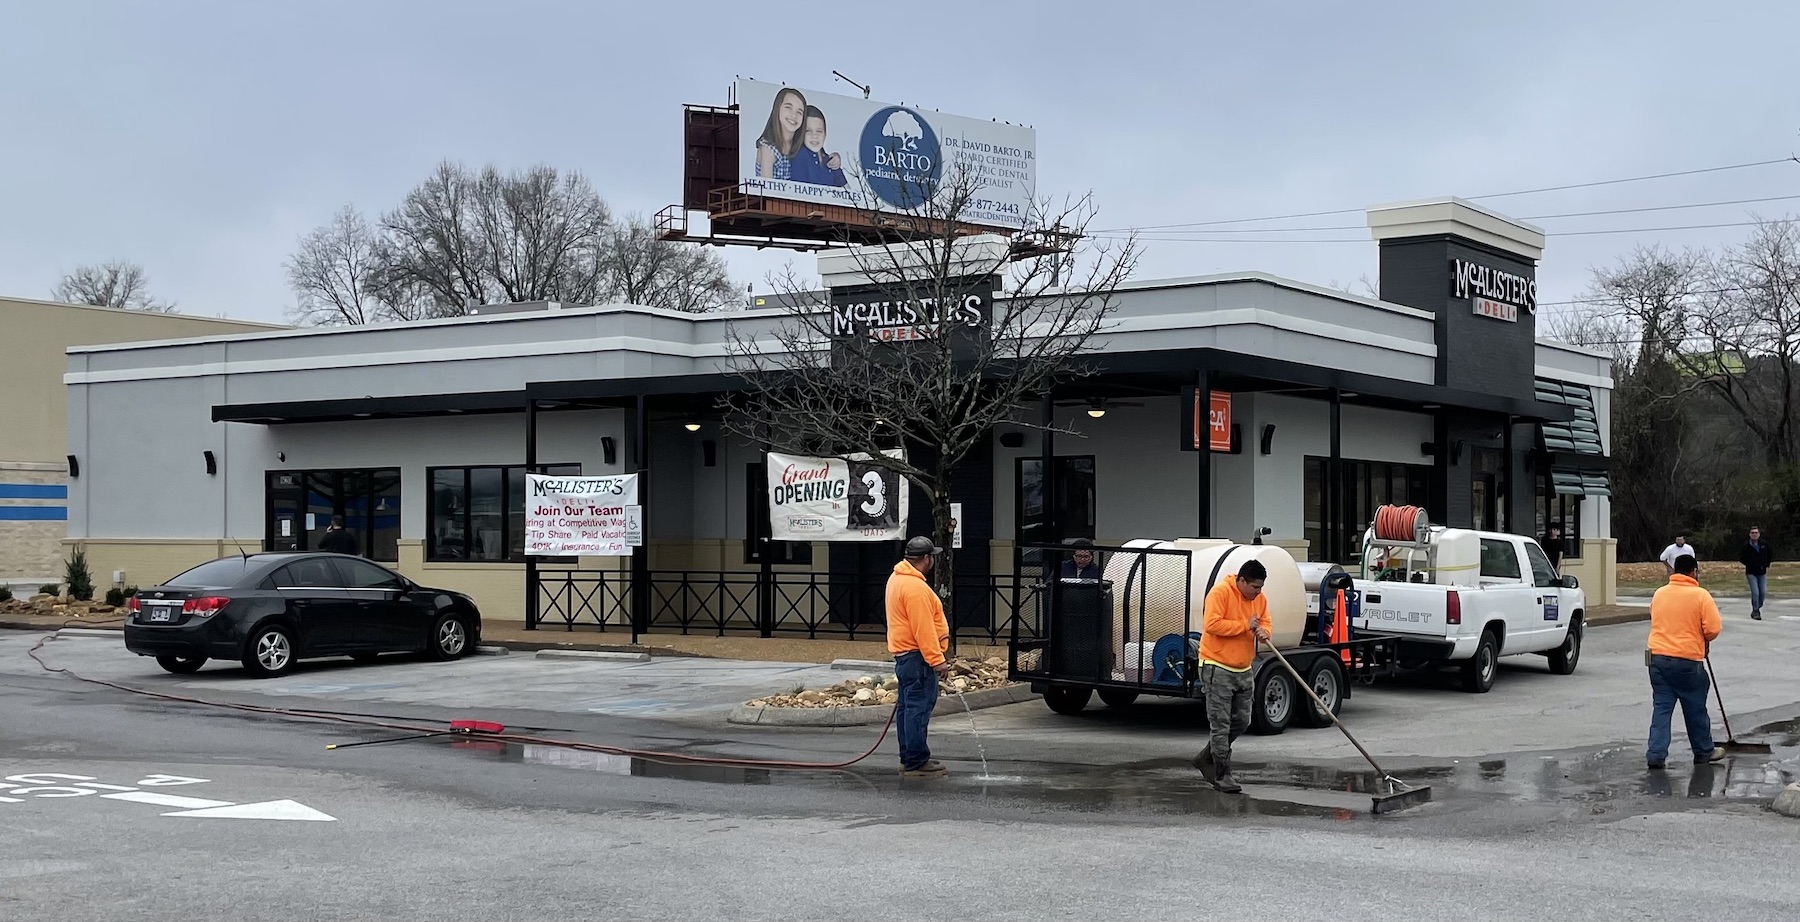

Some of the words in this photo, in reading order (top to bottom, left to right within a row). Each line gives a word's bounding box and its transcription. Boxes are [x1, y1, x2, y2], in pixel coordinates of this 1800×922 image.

[945, 137, 960, 147] DR.
[963, 140, 990, 153] DAVID
[874, 145, 931, 172] BARTO
[955, 151, 984, 163] BOARD
[986, 155, 1028, 169] CERTIFIED
[999, 169, 1029, 181] DENTAL
[794, 184, 824, 197] HAPPY
[832, 189, 862, 201] SMILES
[1484, 301, 1510, 319] DELI
[782, 461, 829, 486] Grand
[774, 479, 845, 505] OPENING
[860, 470, 888, 517] 3
[561, 498, 589, 506] DELI
[534, 506, 561, 516] Join
[564, 506, 584, 516] Our
[588, 506, 623, 516] Team
[547, 518, 556, 527] at
[558, 518, 607, 529] Competitive
[532, 530, 545, 540] Tip
[548, 530, 572, 539] Share
[582, 531, 598, 539] Paid
[864, 528, 885, 537] DAYS
[532, 542, 552, 551] 401K
[608, 542, 623, 551] Fun
